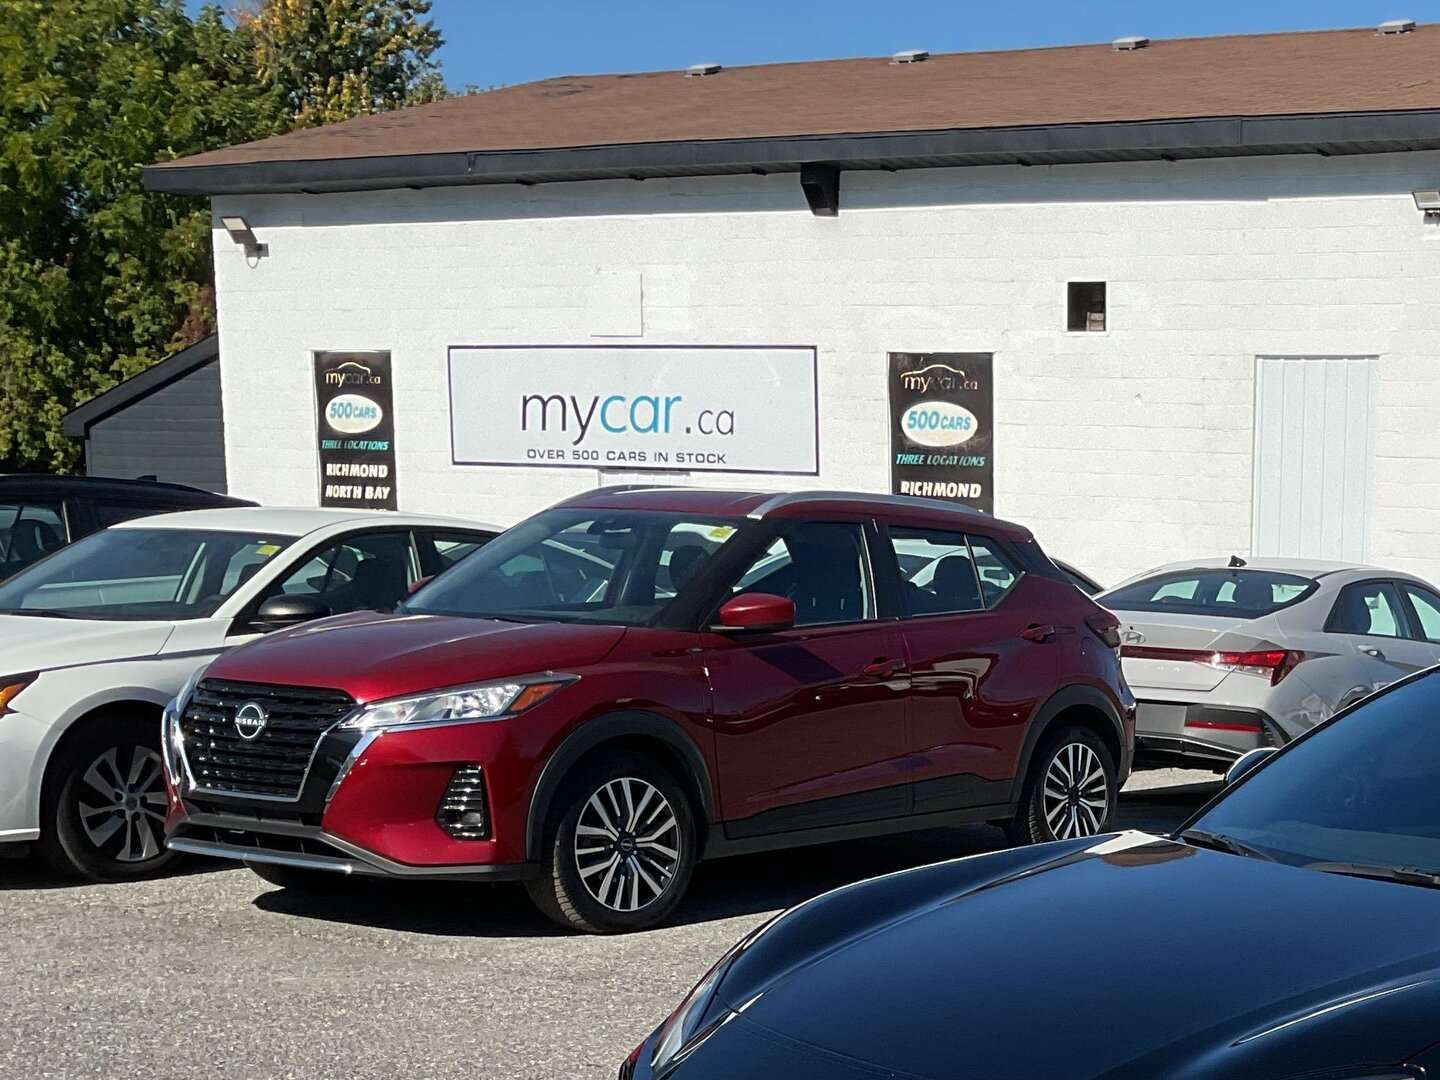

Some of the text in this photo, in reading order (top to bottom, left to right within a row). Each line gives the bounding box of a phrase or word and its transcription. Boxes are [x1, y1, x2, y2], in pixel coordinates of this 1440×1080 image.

[330, 402, 377, 419] 500 CARS
[521, 394, 735, 446] mycar.ca
[907, 410, 971, 430] 500 CARS
[344, 440, 389, 451] LOCATIONS
[527, 449, 727, 464] OVER 500 CARS IN STOCK
[896, 453, 986, 467] THREE LOCATIONS
[326, 463, 388, 478] RICHMOND
[325, 485, 391, 499] NORTH BAY
[900, 480, 982, 498] RICHMOND
[235, 717, 265, 726] NISSAN
